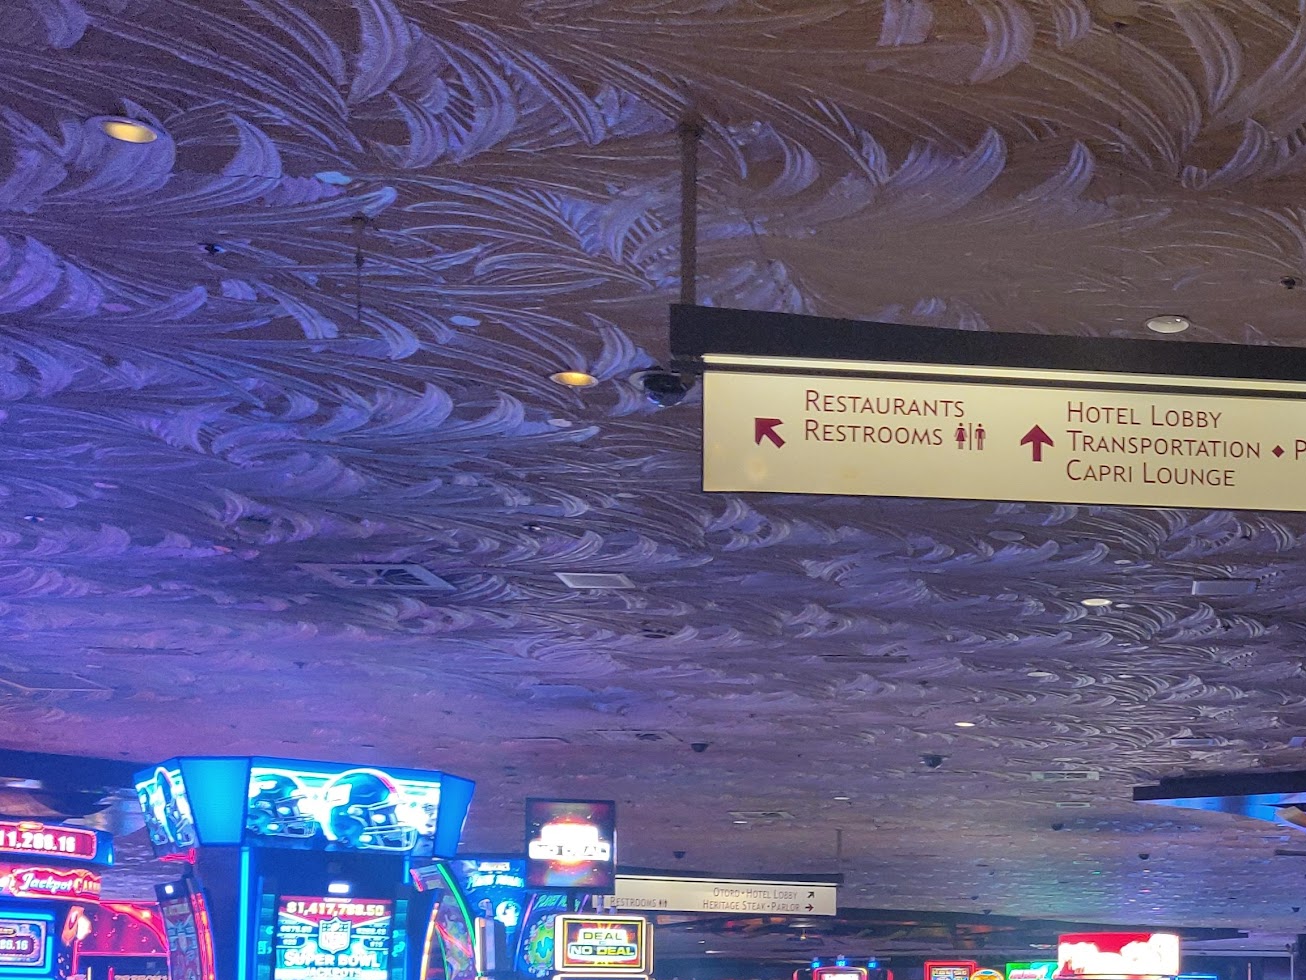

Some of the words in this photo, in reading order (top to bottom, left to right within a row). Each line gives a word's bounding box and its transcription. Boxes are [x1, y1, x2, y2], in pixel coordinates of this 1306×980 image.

[806, 389, 965, 418] RESTAURANTS
[1067, 401, 1141, 426] HOTEL
[1151, 404, 1222, 429] LOBBY
[805, 419, 943, 446] RESTROOMS
[1066, 429, 1261, 459] TRANSPORTATION
[1066, 459, 1132, 484] CAPRI
[1143, 462, 1236, 487] LOUNGE
[611, 897, 657, 908] RESTROOMS
[713, 887, 740, 898] OTORO
[746, 889, 772, 899] HOTEL
[774, 889, 798, 900] LOBBY
[702, 899, 740, 910] HERITAGE
[742, 901, 766, 910] STEAK
[771, 902, 800, 912] PARLOR
[583, 932, 622, 941] DEAL
[284, 949, 335, 966] SUPER
[338, 951, 381, 968] BOWL
[570, 945, 593, 956] NO
[597, 946, 636, 956] DEAL
